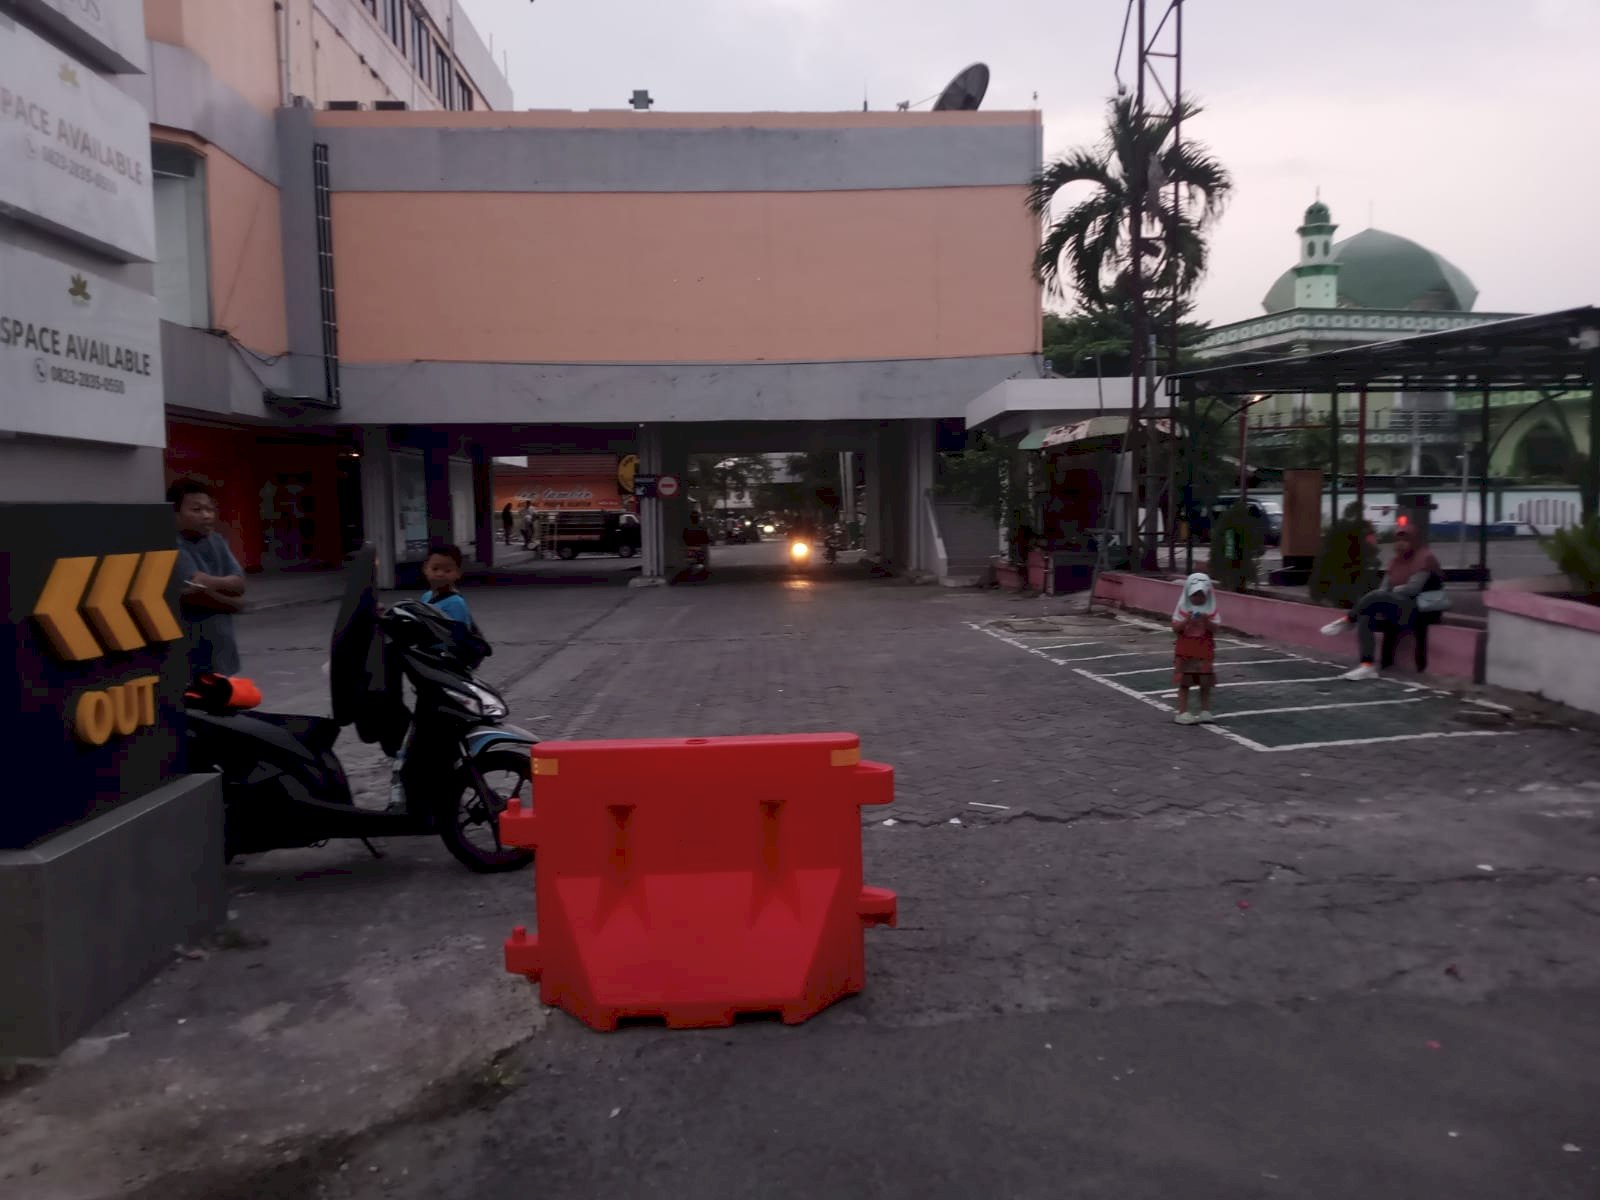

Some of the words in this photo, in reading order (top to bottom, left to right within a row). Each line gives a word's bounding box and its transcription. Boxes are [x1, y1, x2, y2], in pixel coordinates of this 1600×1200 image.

[57, 118, 143, 185] AVAILABLE
[0, 316, 61, 356] SPACE
[66, 334, 151, 376] AVAILABLE
[76, 675, 160, 745] OUT
